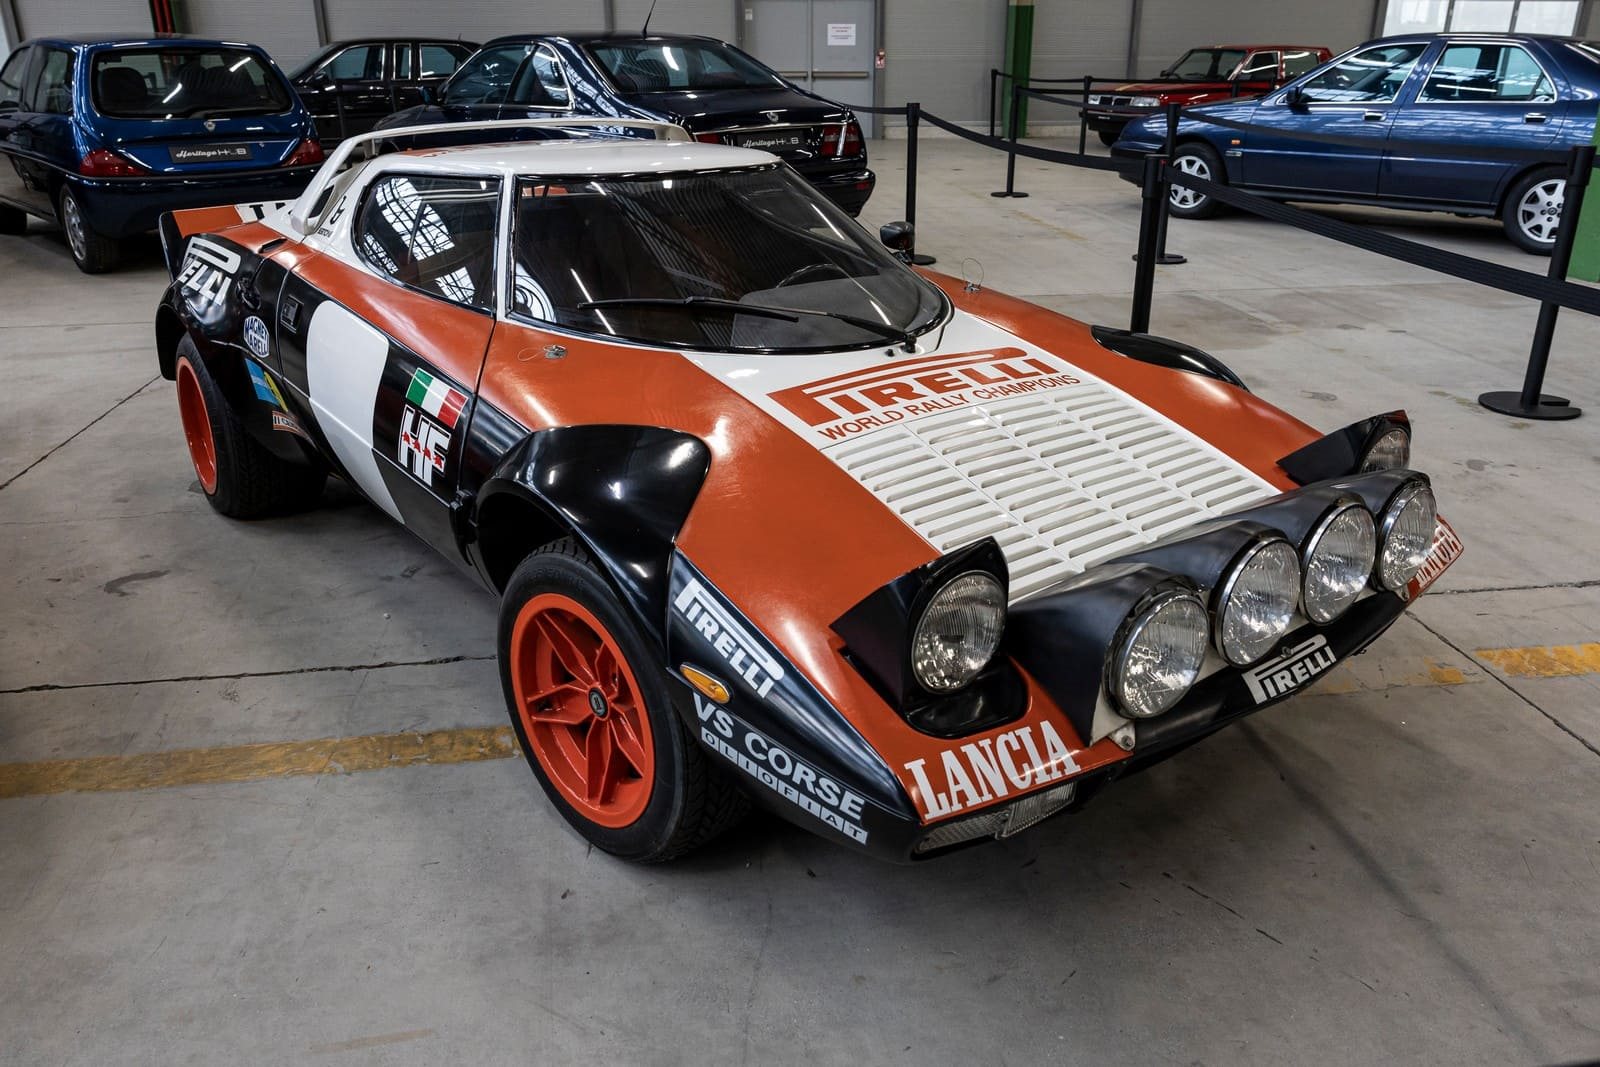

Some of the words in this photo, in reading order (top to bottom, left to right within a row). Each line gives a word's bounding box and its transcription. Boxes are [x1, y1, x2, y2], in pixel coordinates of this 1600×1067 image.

[176, 150, 217, 158] Heritage
[766, 347, 1060, 427] PIRELLI
[817, 409, 905, 441] WORLD
[902, 392, 972, 417] RALLY
[971, 373, 1081, 400] CHAMPIONS
[398, 404, 451, 487] HF
[674, 578, 785, 699] PIRELLI
[1241, 634, 1337, 705] PIRELLI
[692, 691, 734, 738] VS
[744, 731, 865, 821] CORSE
[904, 720, 1082, 820] LANCIA
